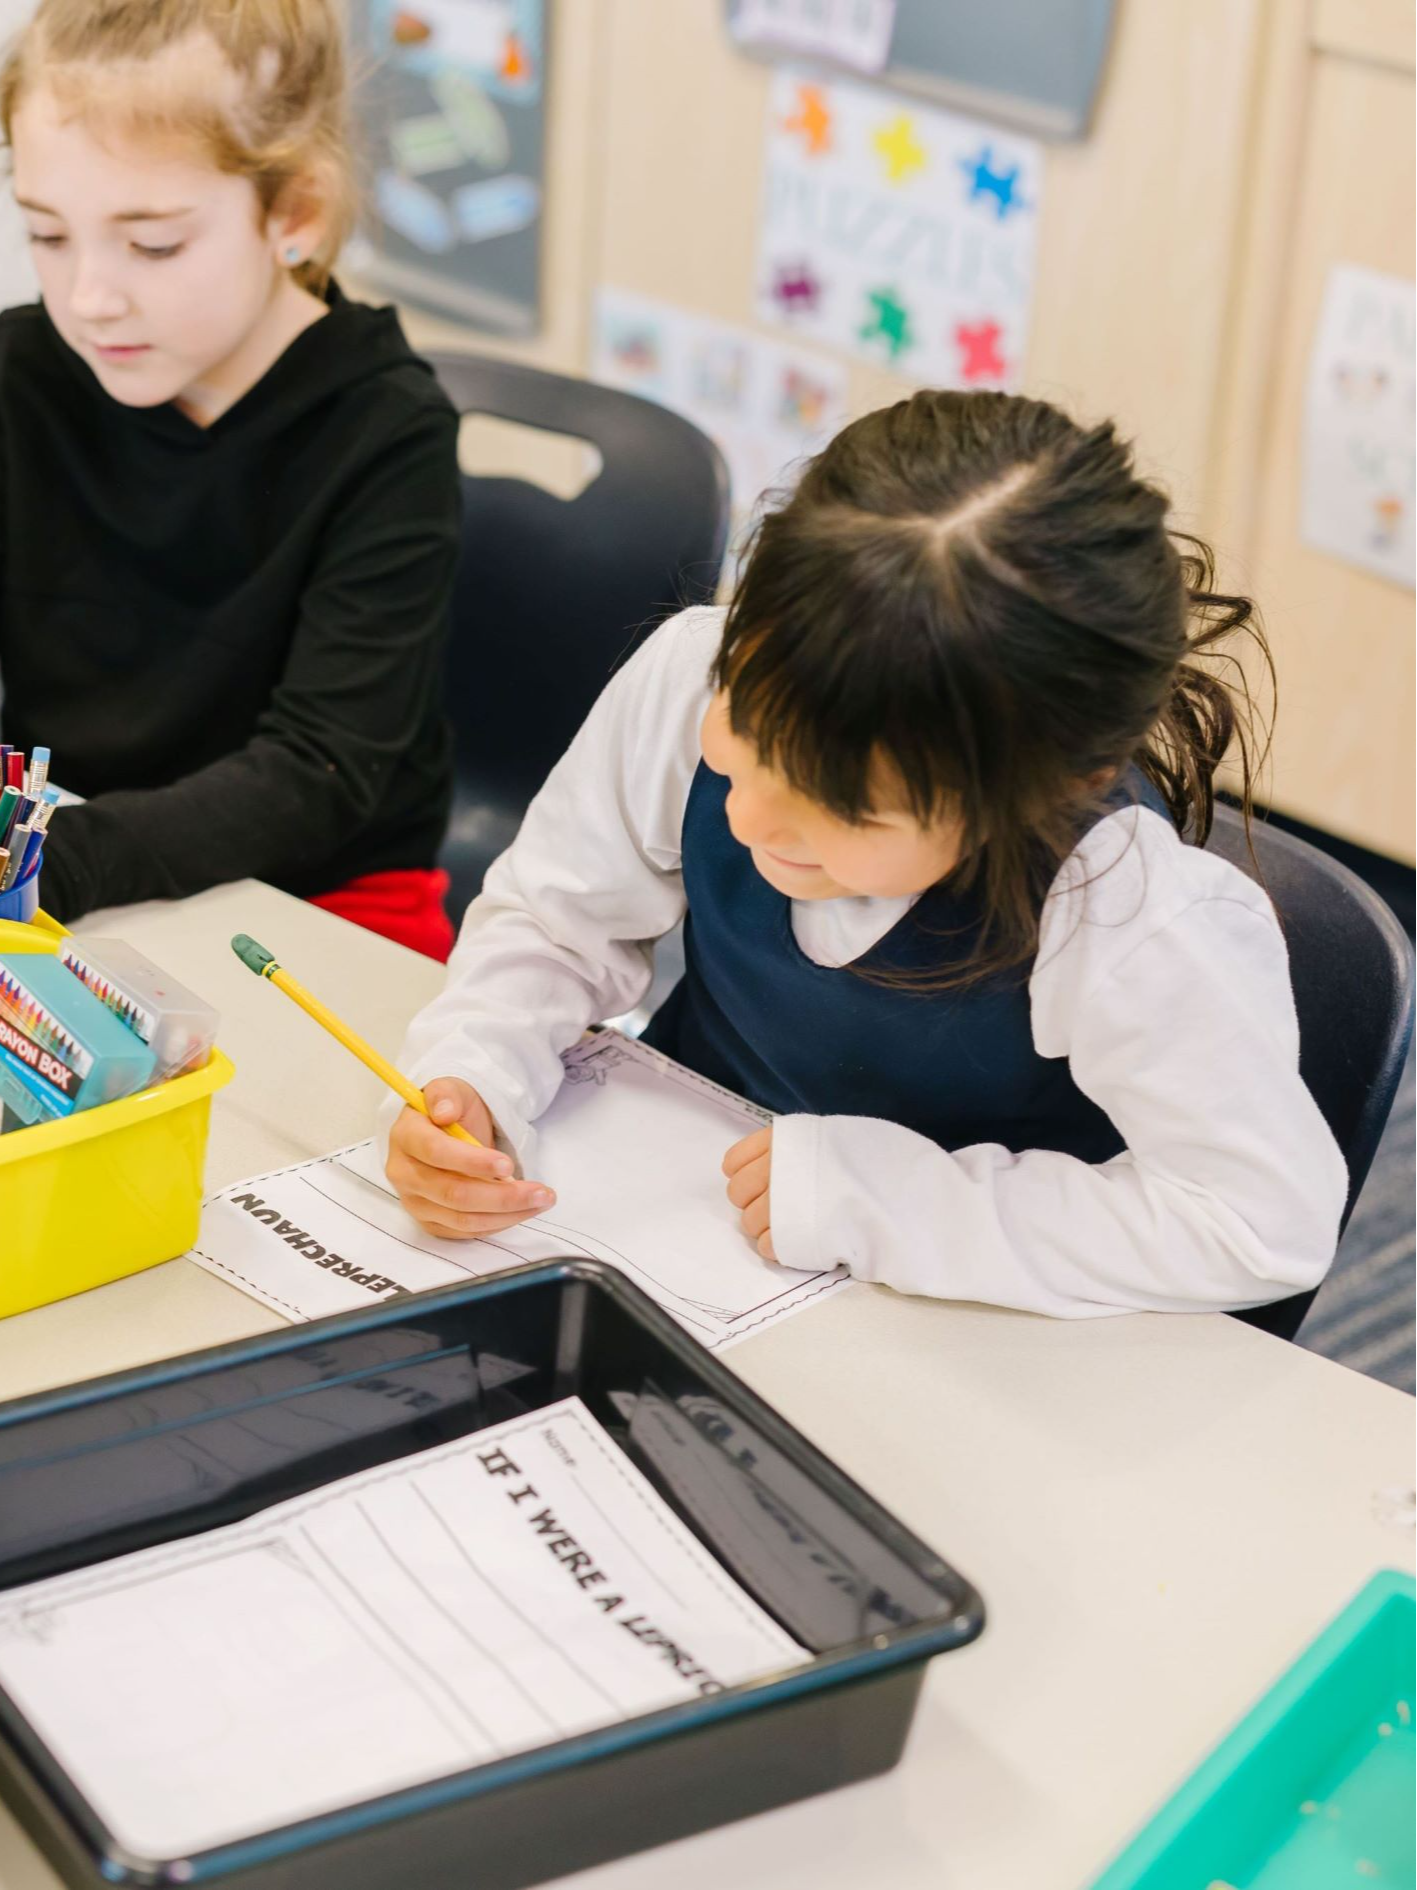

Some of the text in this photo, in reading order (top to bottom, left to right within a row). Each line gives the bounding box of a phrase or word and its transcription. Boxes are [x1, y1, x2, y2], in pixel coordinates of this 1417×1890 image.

[38, 1052, 74, 1090] BOX
[230, 1192, 413, 1301] LEPRECHAUN
[477, 1447, 522, 1478] IF
[508, 1484, 539, 1505] I
[528, 1508, 608, 1590] WERE
[594, 1595, 625, 1614] A
